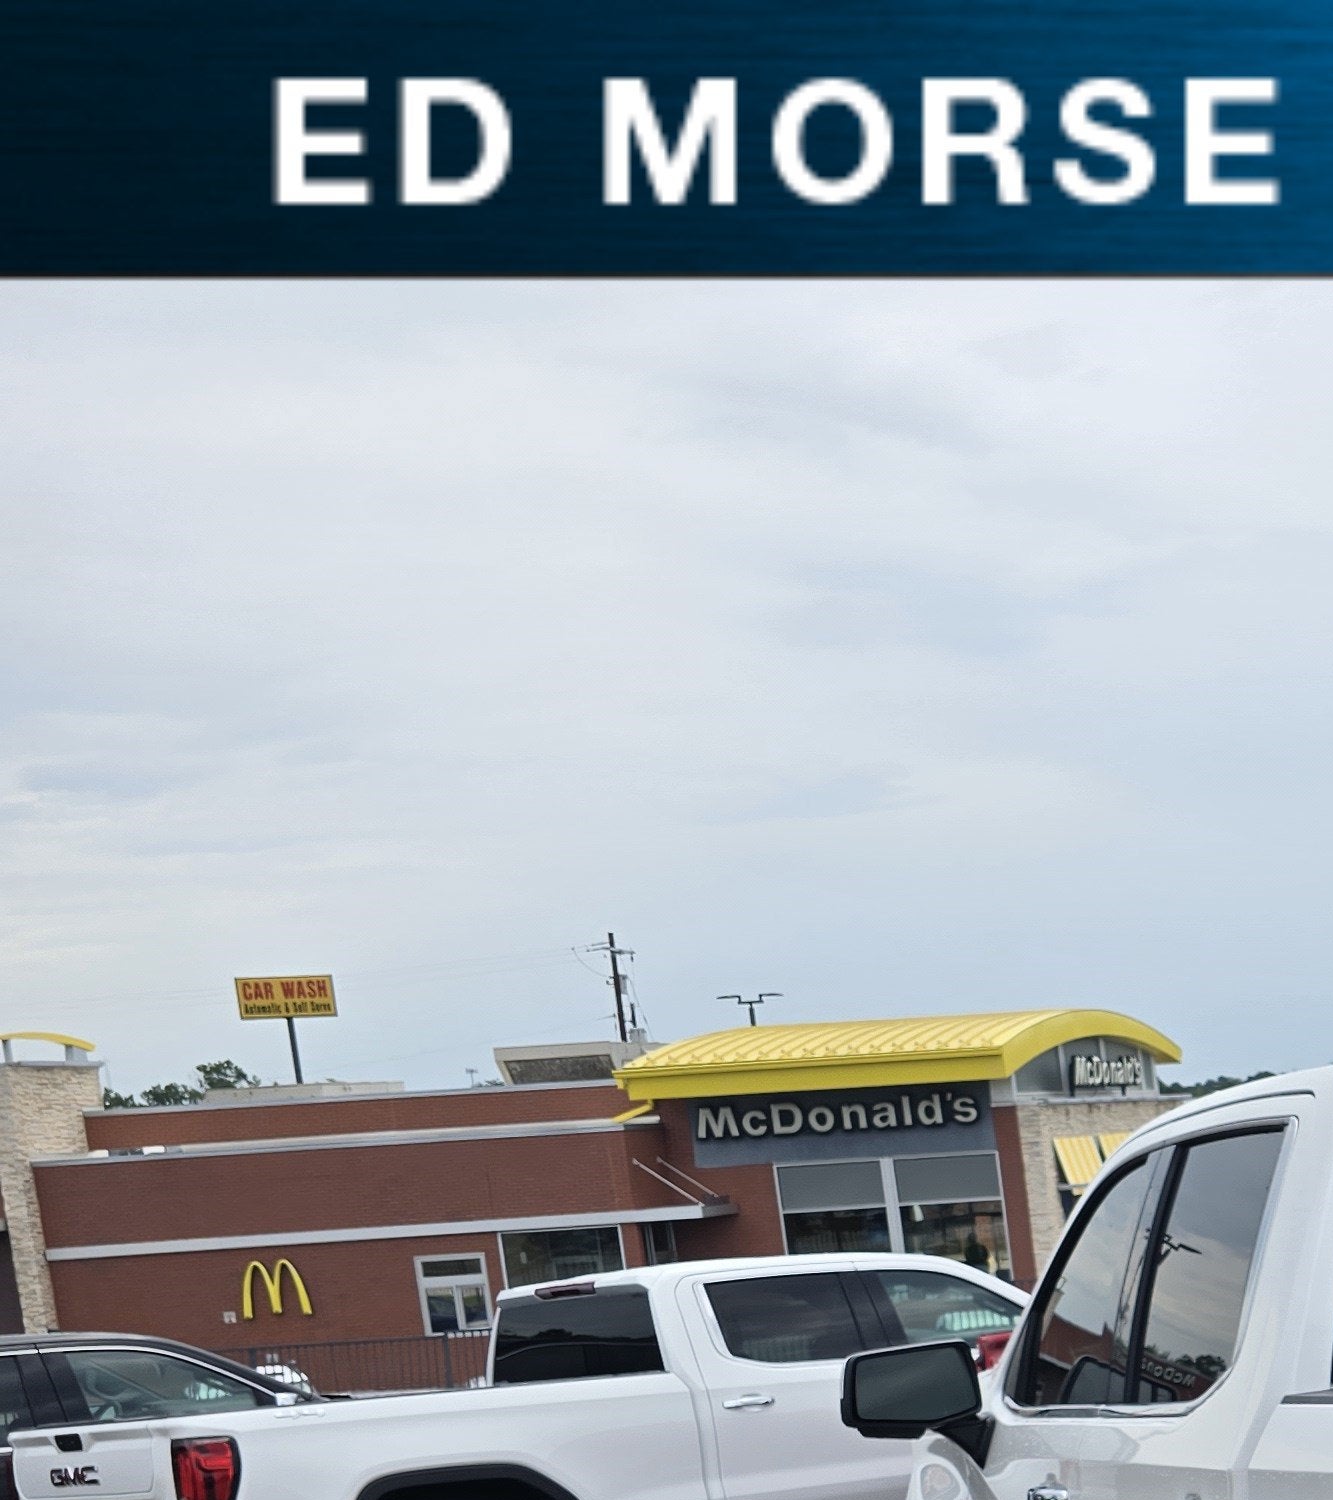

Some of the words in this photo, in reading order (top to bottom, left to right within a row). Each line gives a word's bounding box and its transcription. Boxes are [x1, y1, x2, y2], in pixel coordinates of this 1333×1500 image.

[242, 981, 274, 1001] CAR
[281, 979, 328, 999] WASH
[1074, 1055, 1142, 1087] McDonald's
[697, 1093, 979, 1140] McDonald's
[50, 1465, 99, 1488] GMC
